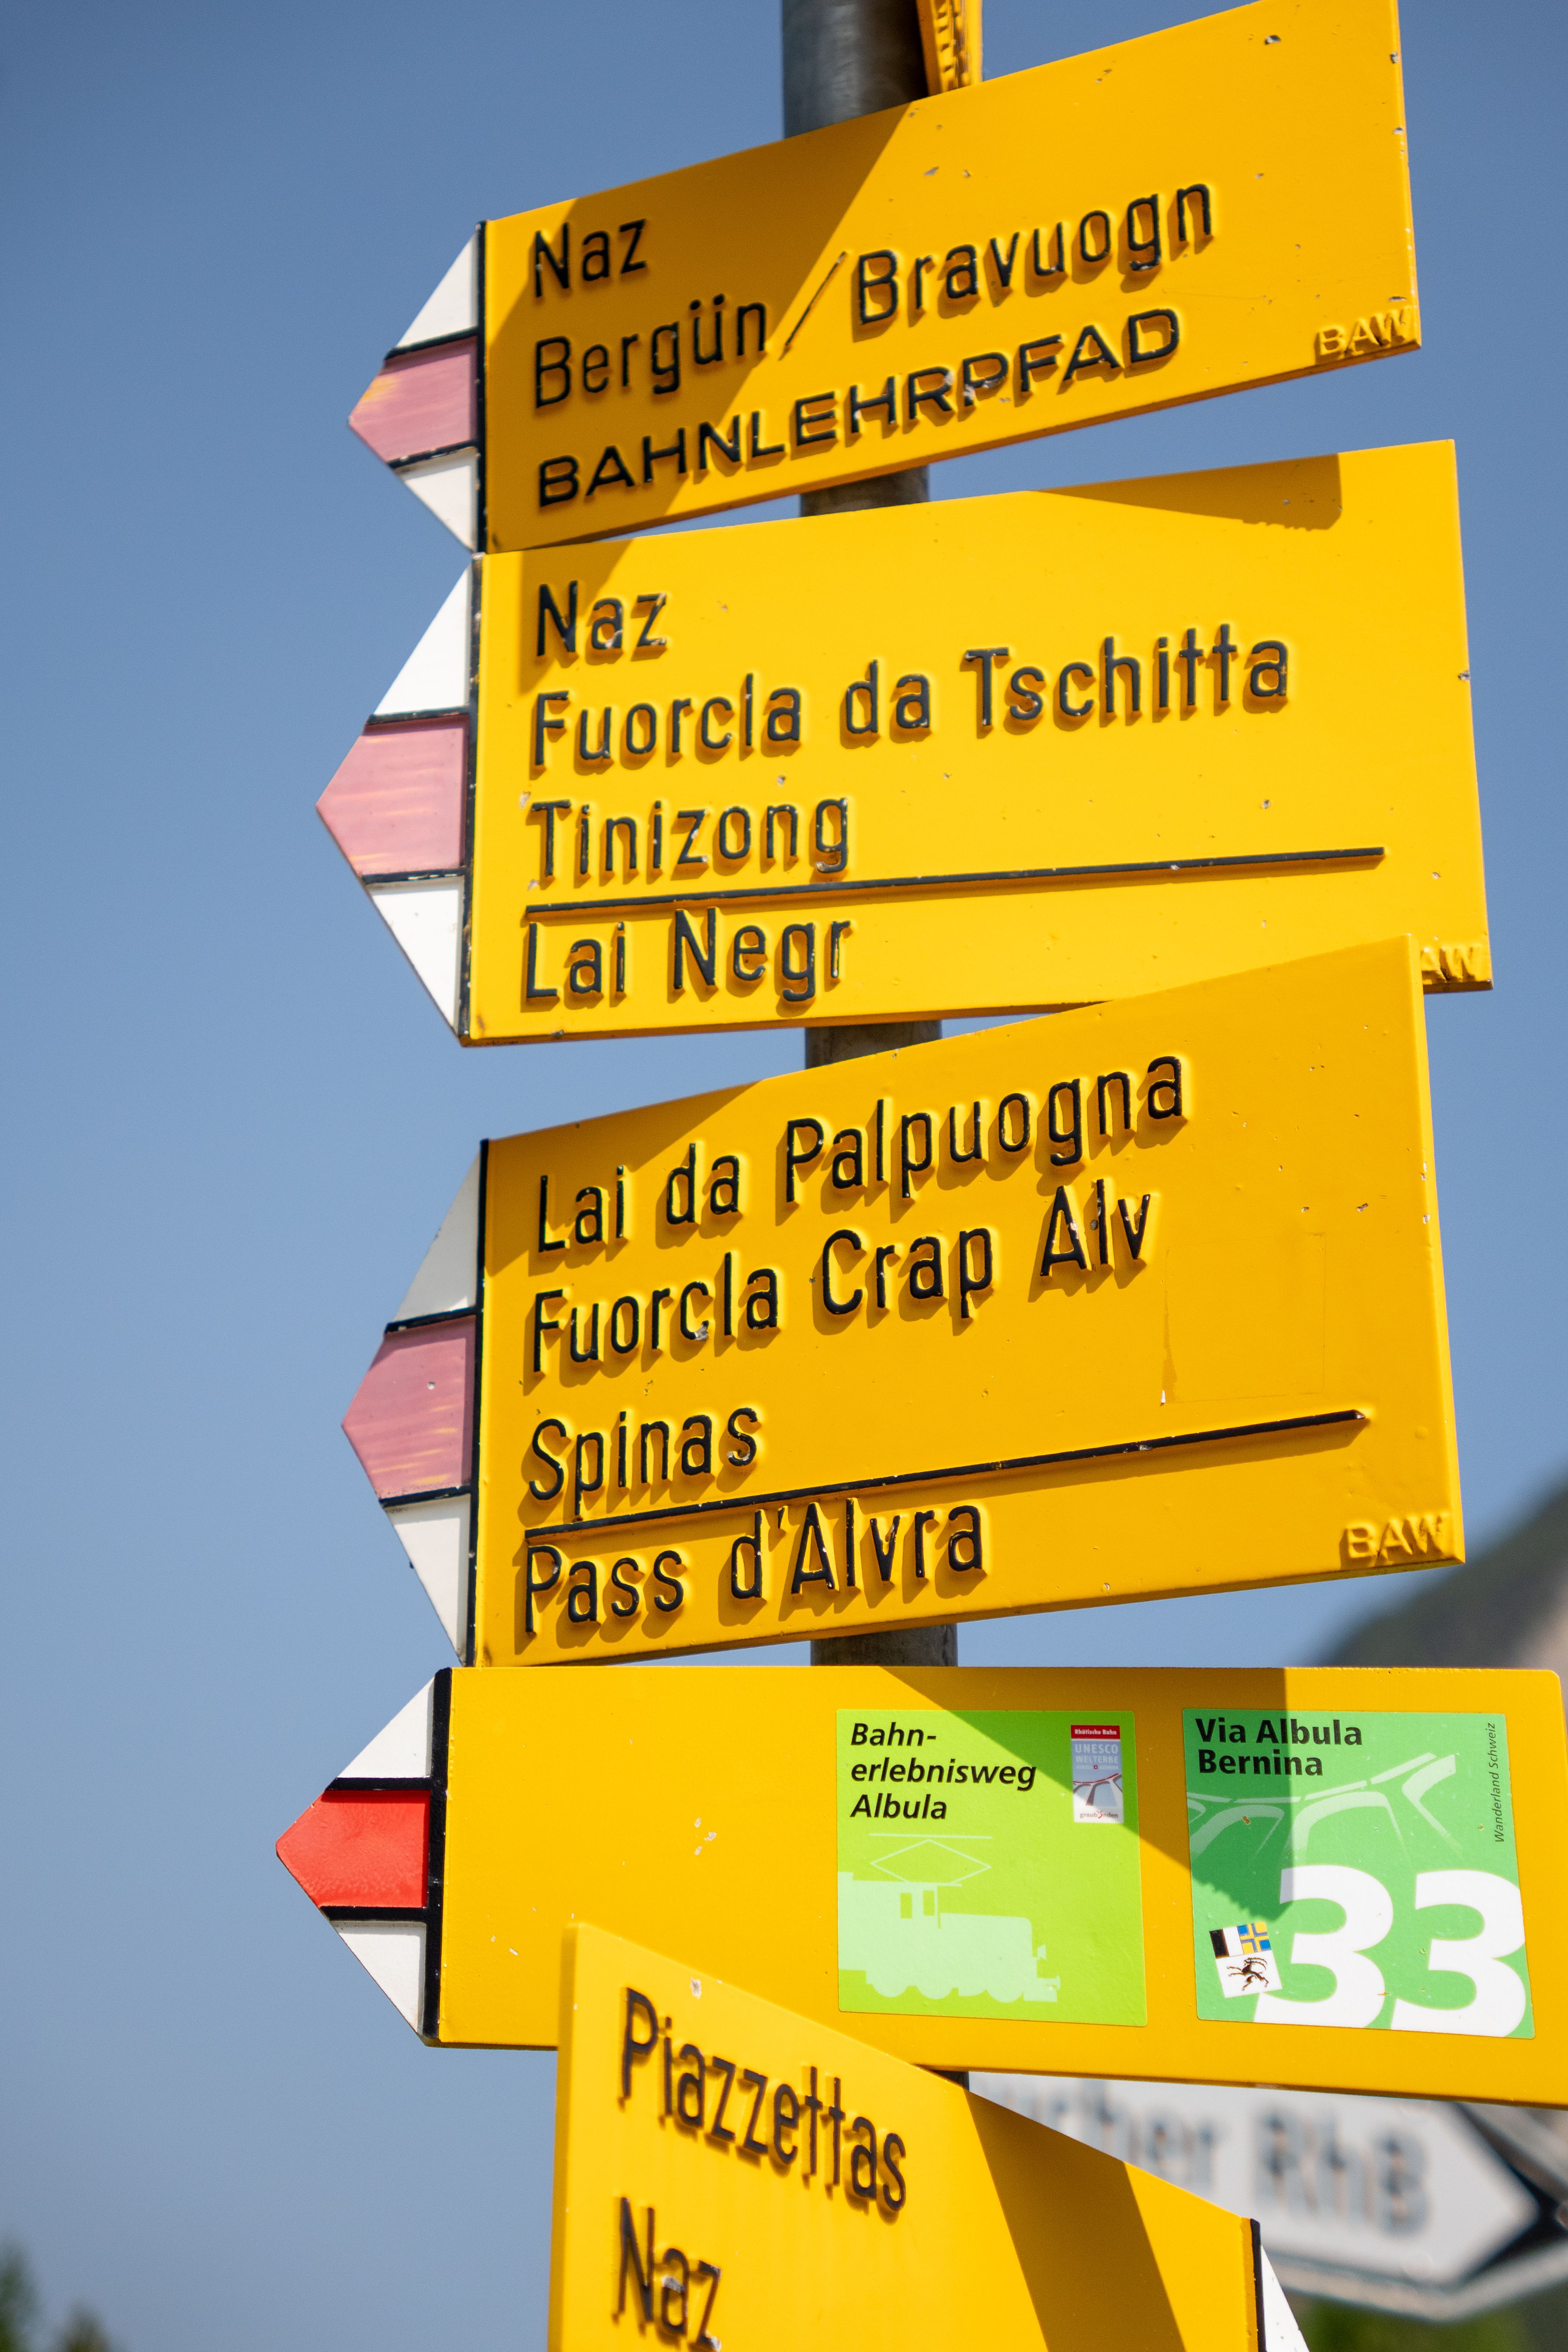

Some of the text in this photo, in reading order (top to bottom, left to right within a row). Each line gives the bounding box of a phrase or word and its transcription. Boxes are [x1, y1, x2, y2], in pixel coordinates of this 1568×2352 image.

[534, 219, 647, 298] Naz
[535, 294, 766, 409] Bergün
[858, 184, 1212, 326] Bravuogn
[1318, 305, 1413, 357] BAW
[537, 308, 1179, 508] BAHNLEHRPFAD
[537, 581, 667, 656] Naz
[535, 625, 1287, 766] Fuorcla da Tschitta
[532, 799, 850, 876] Tinizong
[526, 909, 851, 1001] Lai Negr
[1419, 943, 1483, 984] AW
[538, 1055, 1182, 1252] Lai da Palpuogna
[534, 1179, 1150, 1372] Fuorcla Crap Alv
[530, 1408, 758, 1516] Spinas
[525, 1496, 982, 1636] Pass d'Alvra
[1345, 1511, 1451, 1560] BAW
[851, 1721, 937, 1746] Bahn-
[1075, 1743, 1118, 1754] UNESCO
[1075, 1756, 1119, 1764] WELTERBE
[1195, 1717, 1363, 1746] Via Albula
[1198, 1749, 1324, 1776] Bernina
[850, 1792, 948, 1819] Albula
[851, 1757, 1037, 1792] erlebnisweg
[1485, 1722, 1505, 1842] Wanderland Schweiz
[1254, 1864, 1526, 2038] 33
[622, 1987, 906, 2211] Piazzettas
[619, 2197, 721, 2352] Naz
